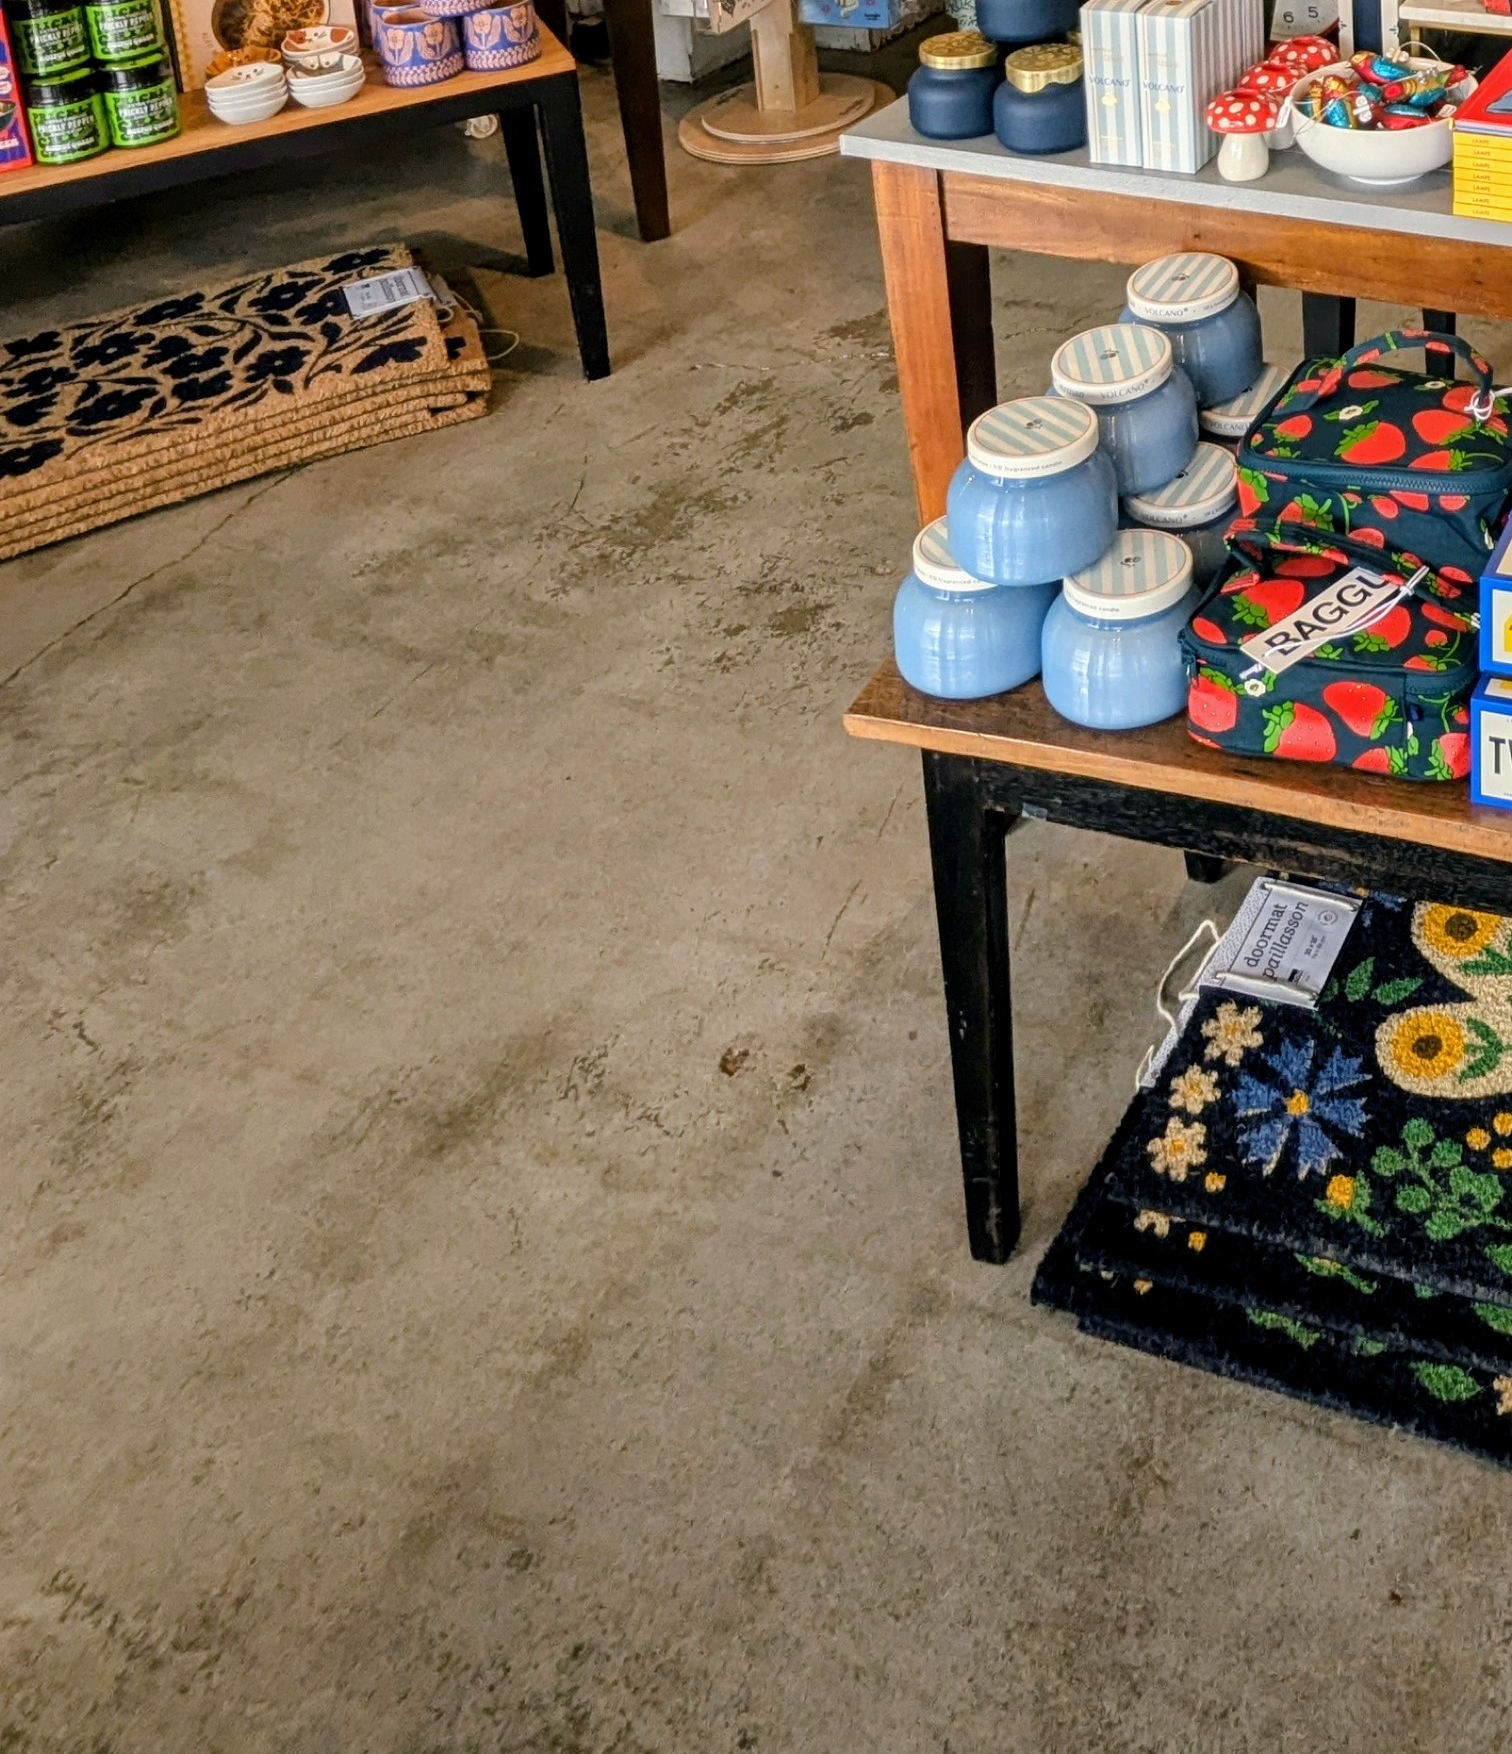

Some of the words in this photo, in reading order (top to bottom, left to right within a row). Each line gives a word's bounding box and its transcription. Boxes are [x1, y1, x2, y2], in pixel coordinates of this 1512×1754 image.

[1283, 11, 1294, 23] 6
[1307, 6, 1318, 19] 5
[1243, 903, 1288, 968] doormat
[1262, 901, 1309, 982] paillasson
